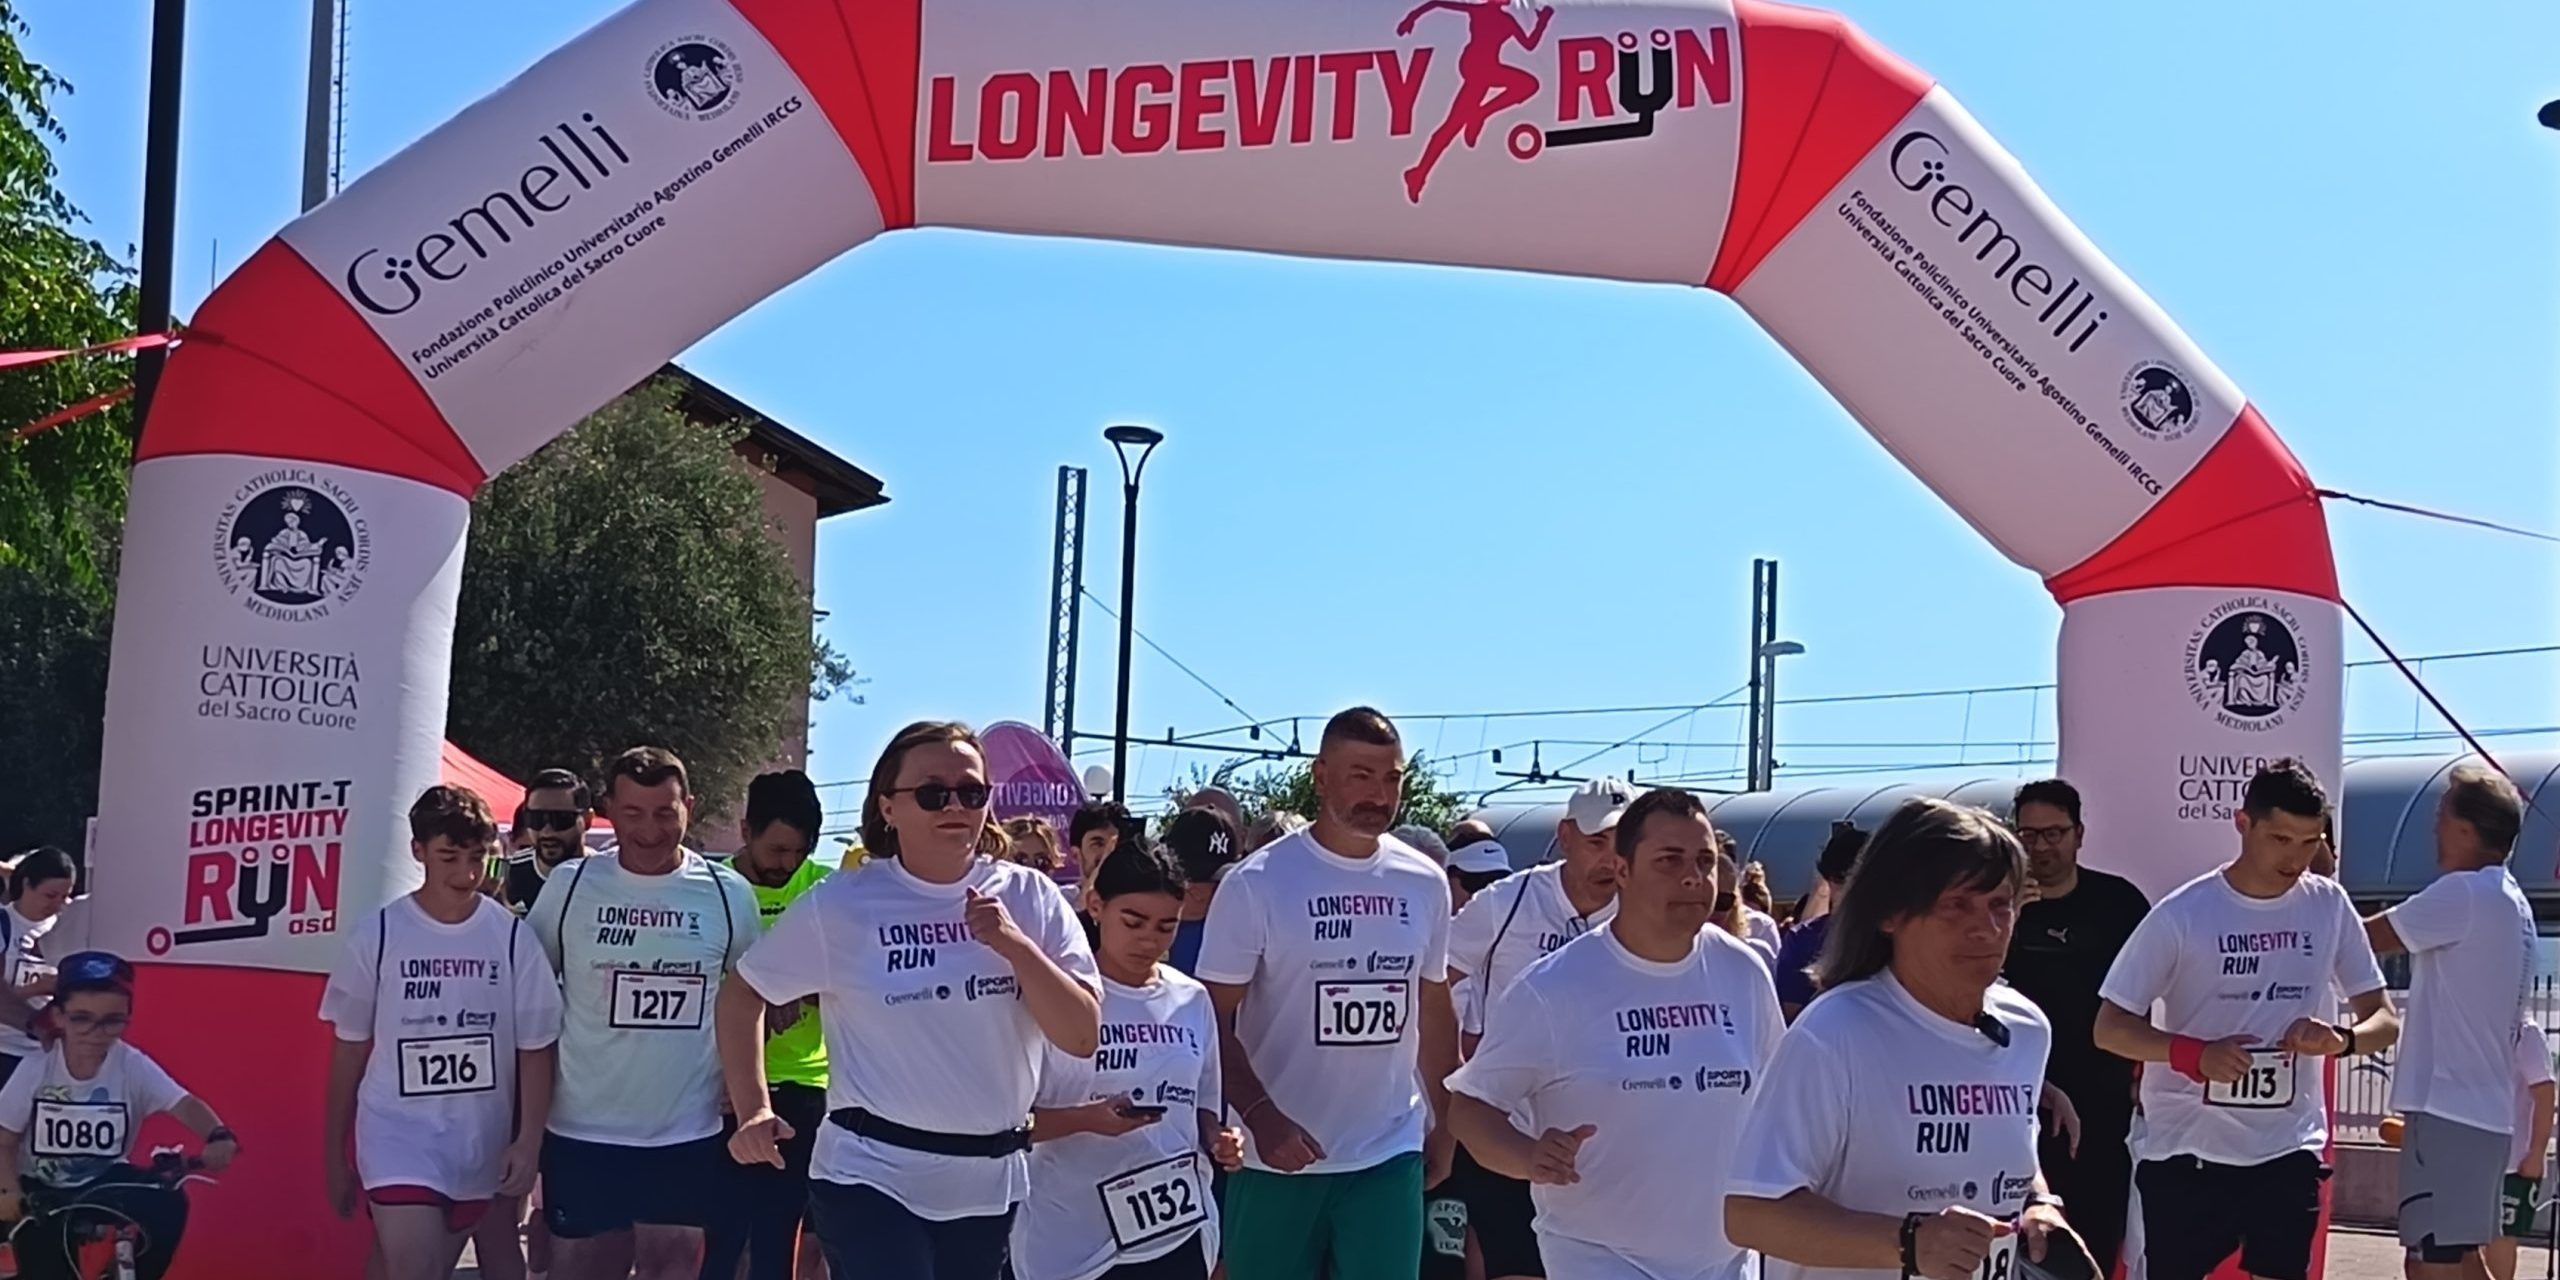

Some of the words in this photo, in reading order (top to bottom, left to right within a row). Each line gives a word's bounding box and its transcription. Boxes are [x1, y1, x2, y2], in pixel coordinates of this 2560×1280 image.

[928, 48, 1434, 162] LONGEVITY
[347, 113, 629, 315] Gemelli
[412, 306, 495, 364] Fondazione
[492, 260, 565, 311] Policlinico
[563, 200, 653, 263] Universitario
[653, 159, 713, 204] Agostino
[712, 121, 766, 163] Gemelli
[763, 96, 802, 130] IRCCS
[1890, 131, 2107, 352] Gemelli
[424, 327, 499, 379] Università
[499, 287, 561, 331] Cattolica
[562, 268, 585, 290] del
[585, 244, 624, 275] Sacro
[624, 215, 666, 247] Cuore
[1838, 203, 1896, 262] Università
[1895, 260, 1943, 310] Cattolica
[1942, 309, 1964, 329] del
[1961, 326, 1992, 359] Sacro
[1992, 357, 2026, 392] Cuore
[1851, 190, 1914, 254] Fondazione
[1913, 252, 1968, 309] Policlinico
[1968, 307, 2038, 378] Universitario
[2037, 377, 2086, 425] Agostino
[2086, 423, 2130, 466] Gemelli
[2127, 462, 2162, 496] IRCCS
[235, 469, 316, 501] CATHOLICA
[203, 645, 360, 683] UNIVERSITÀ
[201, 671, 358, 709] CATTOLICA
[198, 700, 229, 717] del
[236, 701, 291, 722] Sacro
[298, 707, 357, 730] Cuore
[192, 781, 352, 817] SPRINT-T
[2178, 804, 2206, 820] del
[190, 808, 349, 848] LONGEVITY
[597, 907, 683, 928] LONGEVITY
[1308, 895, 1394, 917] LONGEVITY
[289, 911, 336, 934] asd
[597, 927, 637, 946] RUN
[1315, 919, 1352, 941] RUN
[2218, 931, 2298, 953] LONGEVITY
[400, 959, 485, 978] LONGEVITY
[887, 947, 936, 973] RUN
[2222, 956, 2259, 975] RUN
[404, 981, 441, 1000] RUN
[632, 990, 687, 1020] 1217
[1333, 1000, 1395, 1035] 1078
[1616, 1003, 1717, 1032] LONGEVITY
[1098, 1023, 1184, 1045] ONGEVITY
[1627, 1033, 1670, 1057] RUN
[418, 1053, 477, 1086] 1216
[1095, 1047, 1138, 1072] RUN
[1907, 1084, 2020, 1115] LONGEVITY
[45, 1118, 114, 1150] 1080
[1916, 1122, 1970, 1153] RUN
[1126, 1178, 1196, 1230] 1132
